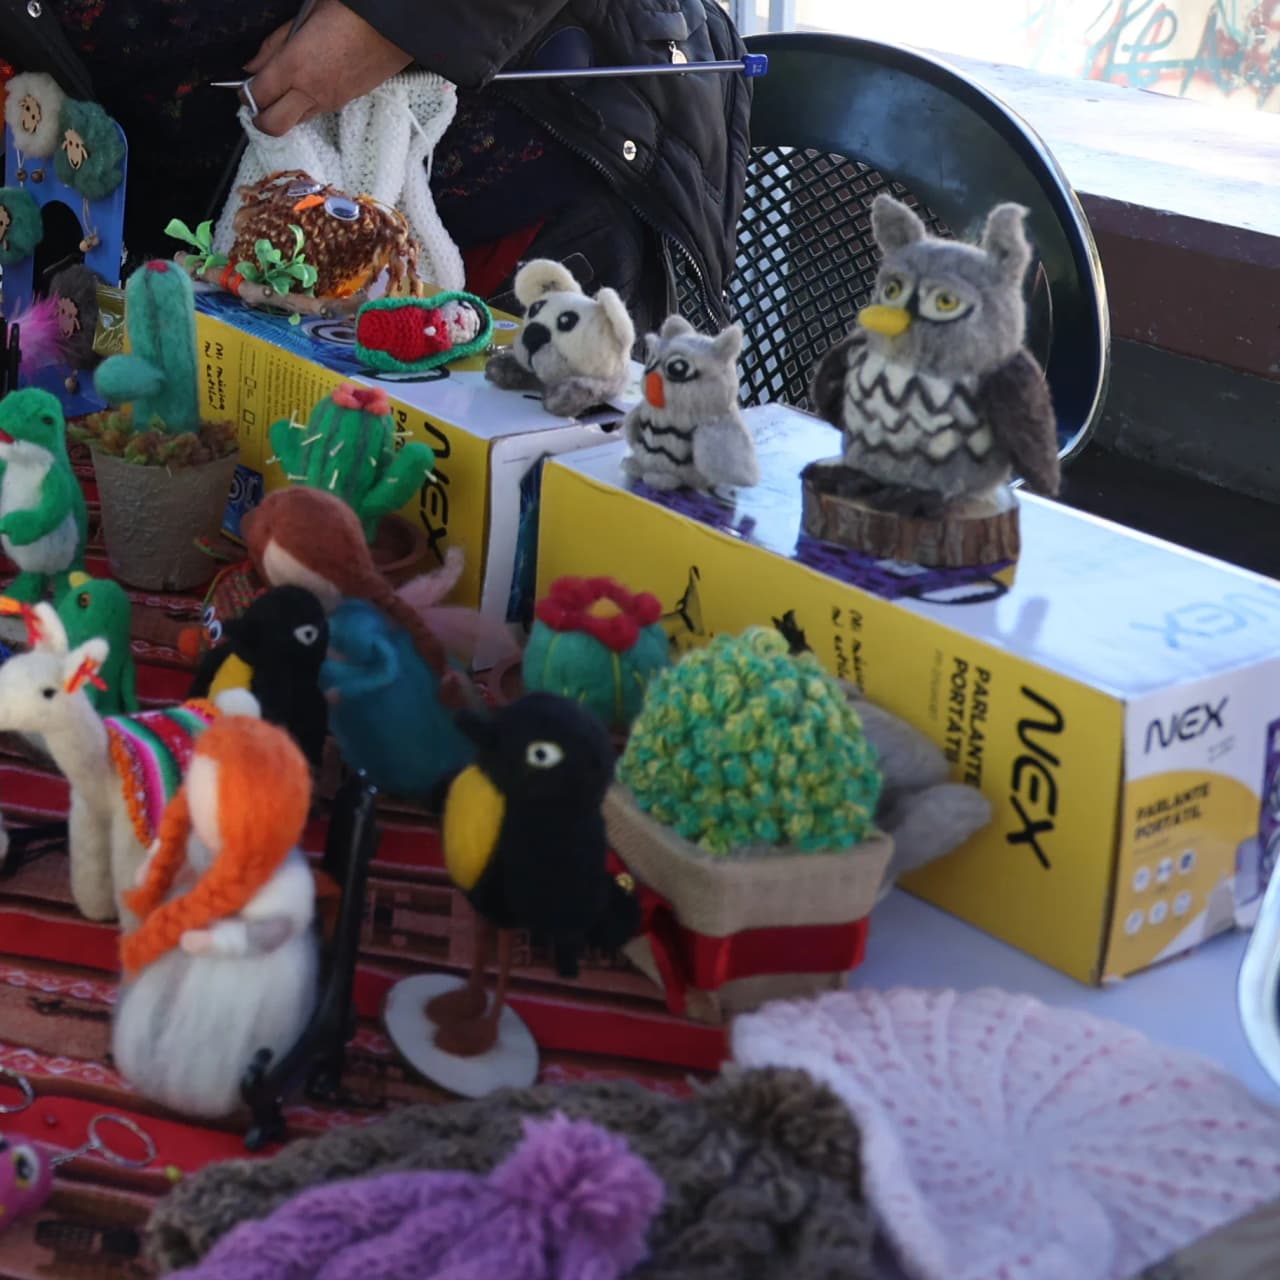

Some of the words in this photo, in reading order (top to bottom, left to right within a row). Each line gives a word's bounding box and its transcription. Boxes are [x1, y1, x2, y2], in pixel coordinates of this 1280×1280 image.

[963, 666, 992, 789] PARLANTE
[1144, 696, 1230, 755] NEX
[1005, 685, 1066, 870] NEX
[1135, 781, 1211, 823] PARLANTE
